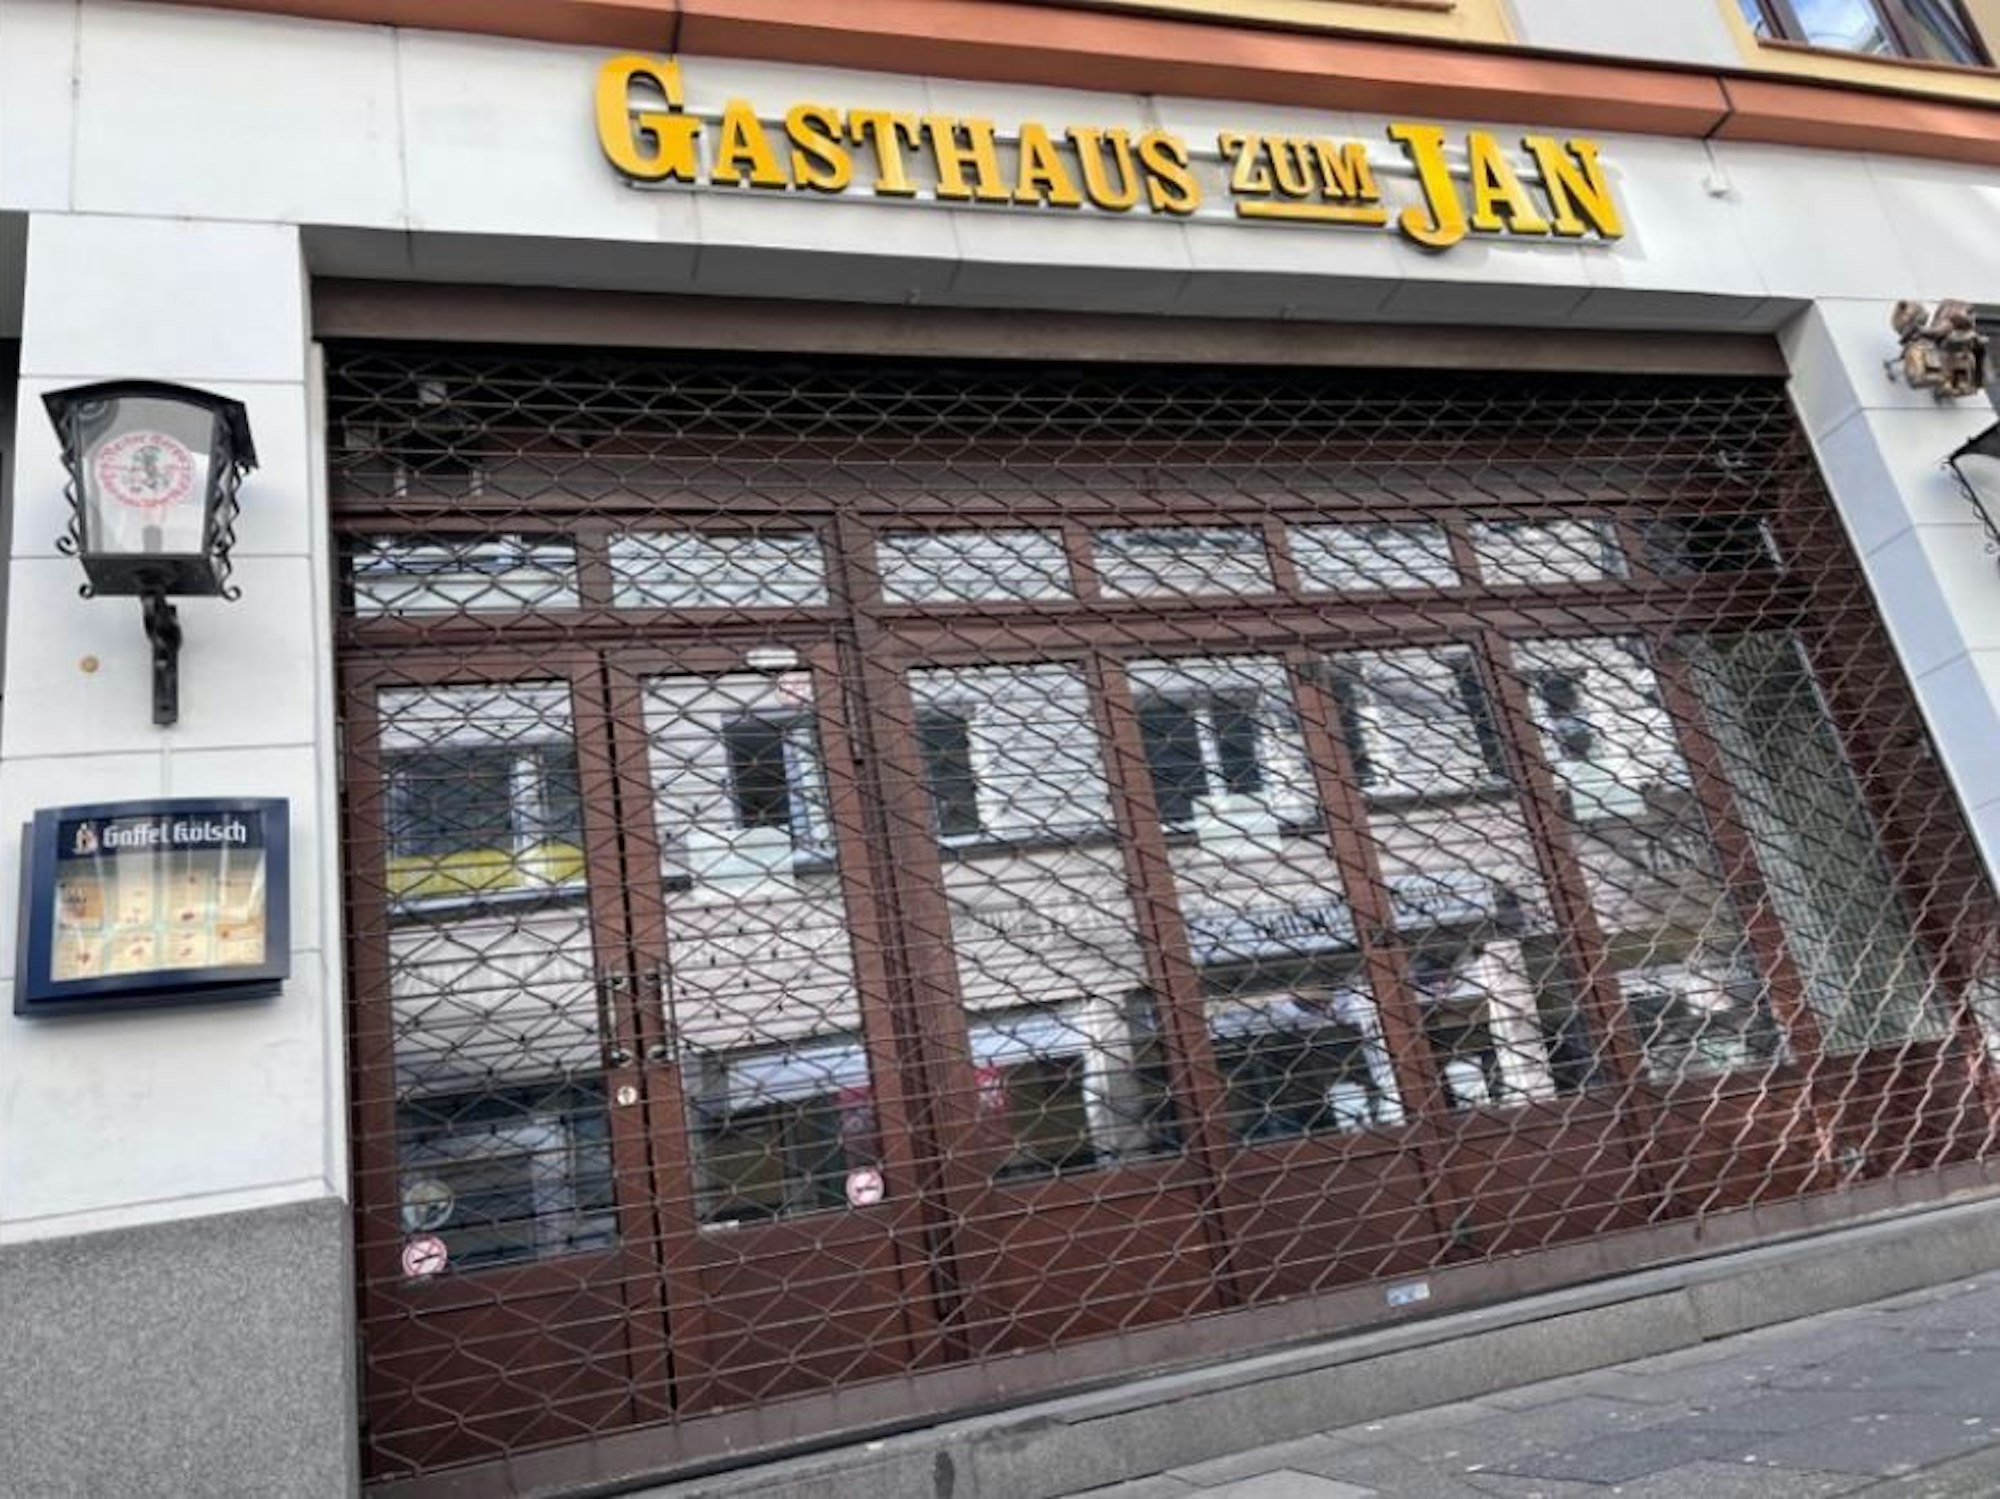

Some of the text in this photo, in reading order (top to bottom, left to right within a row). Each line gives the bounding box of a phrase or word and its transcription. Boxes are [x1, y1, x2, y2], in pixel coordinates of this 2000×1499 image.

[594, 54, 1624, 249] GASTHAUS ZUM JAN
[103, 822, 169, 848] Gaffel
